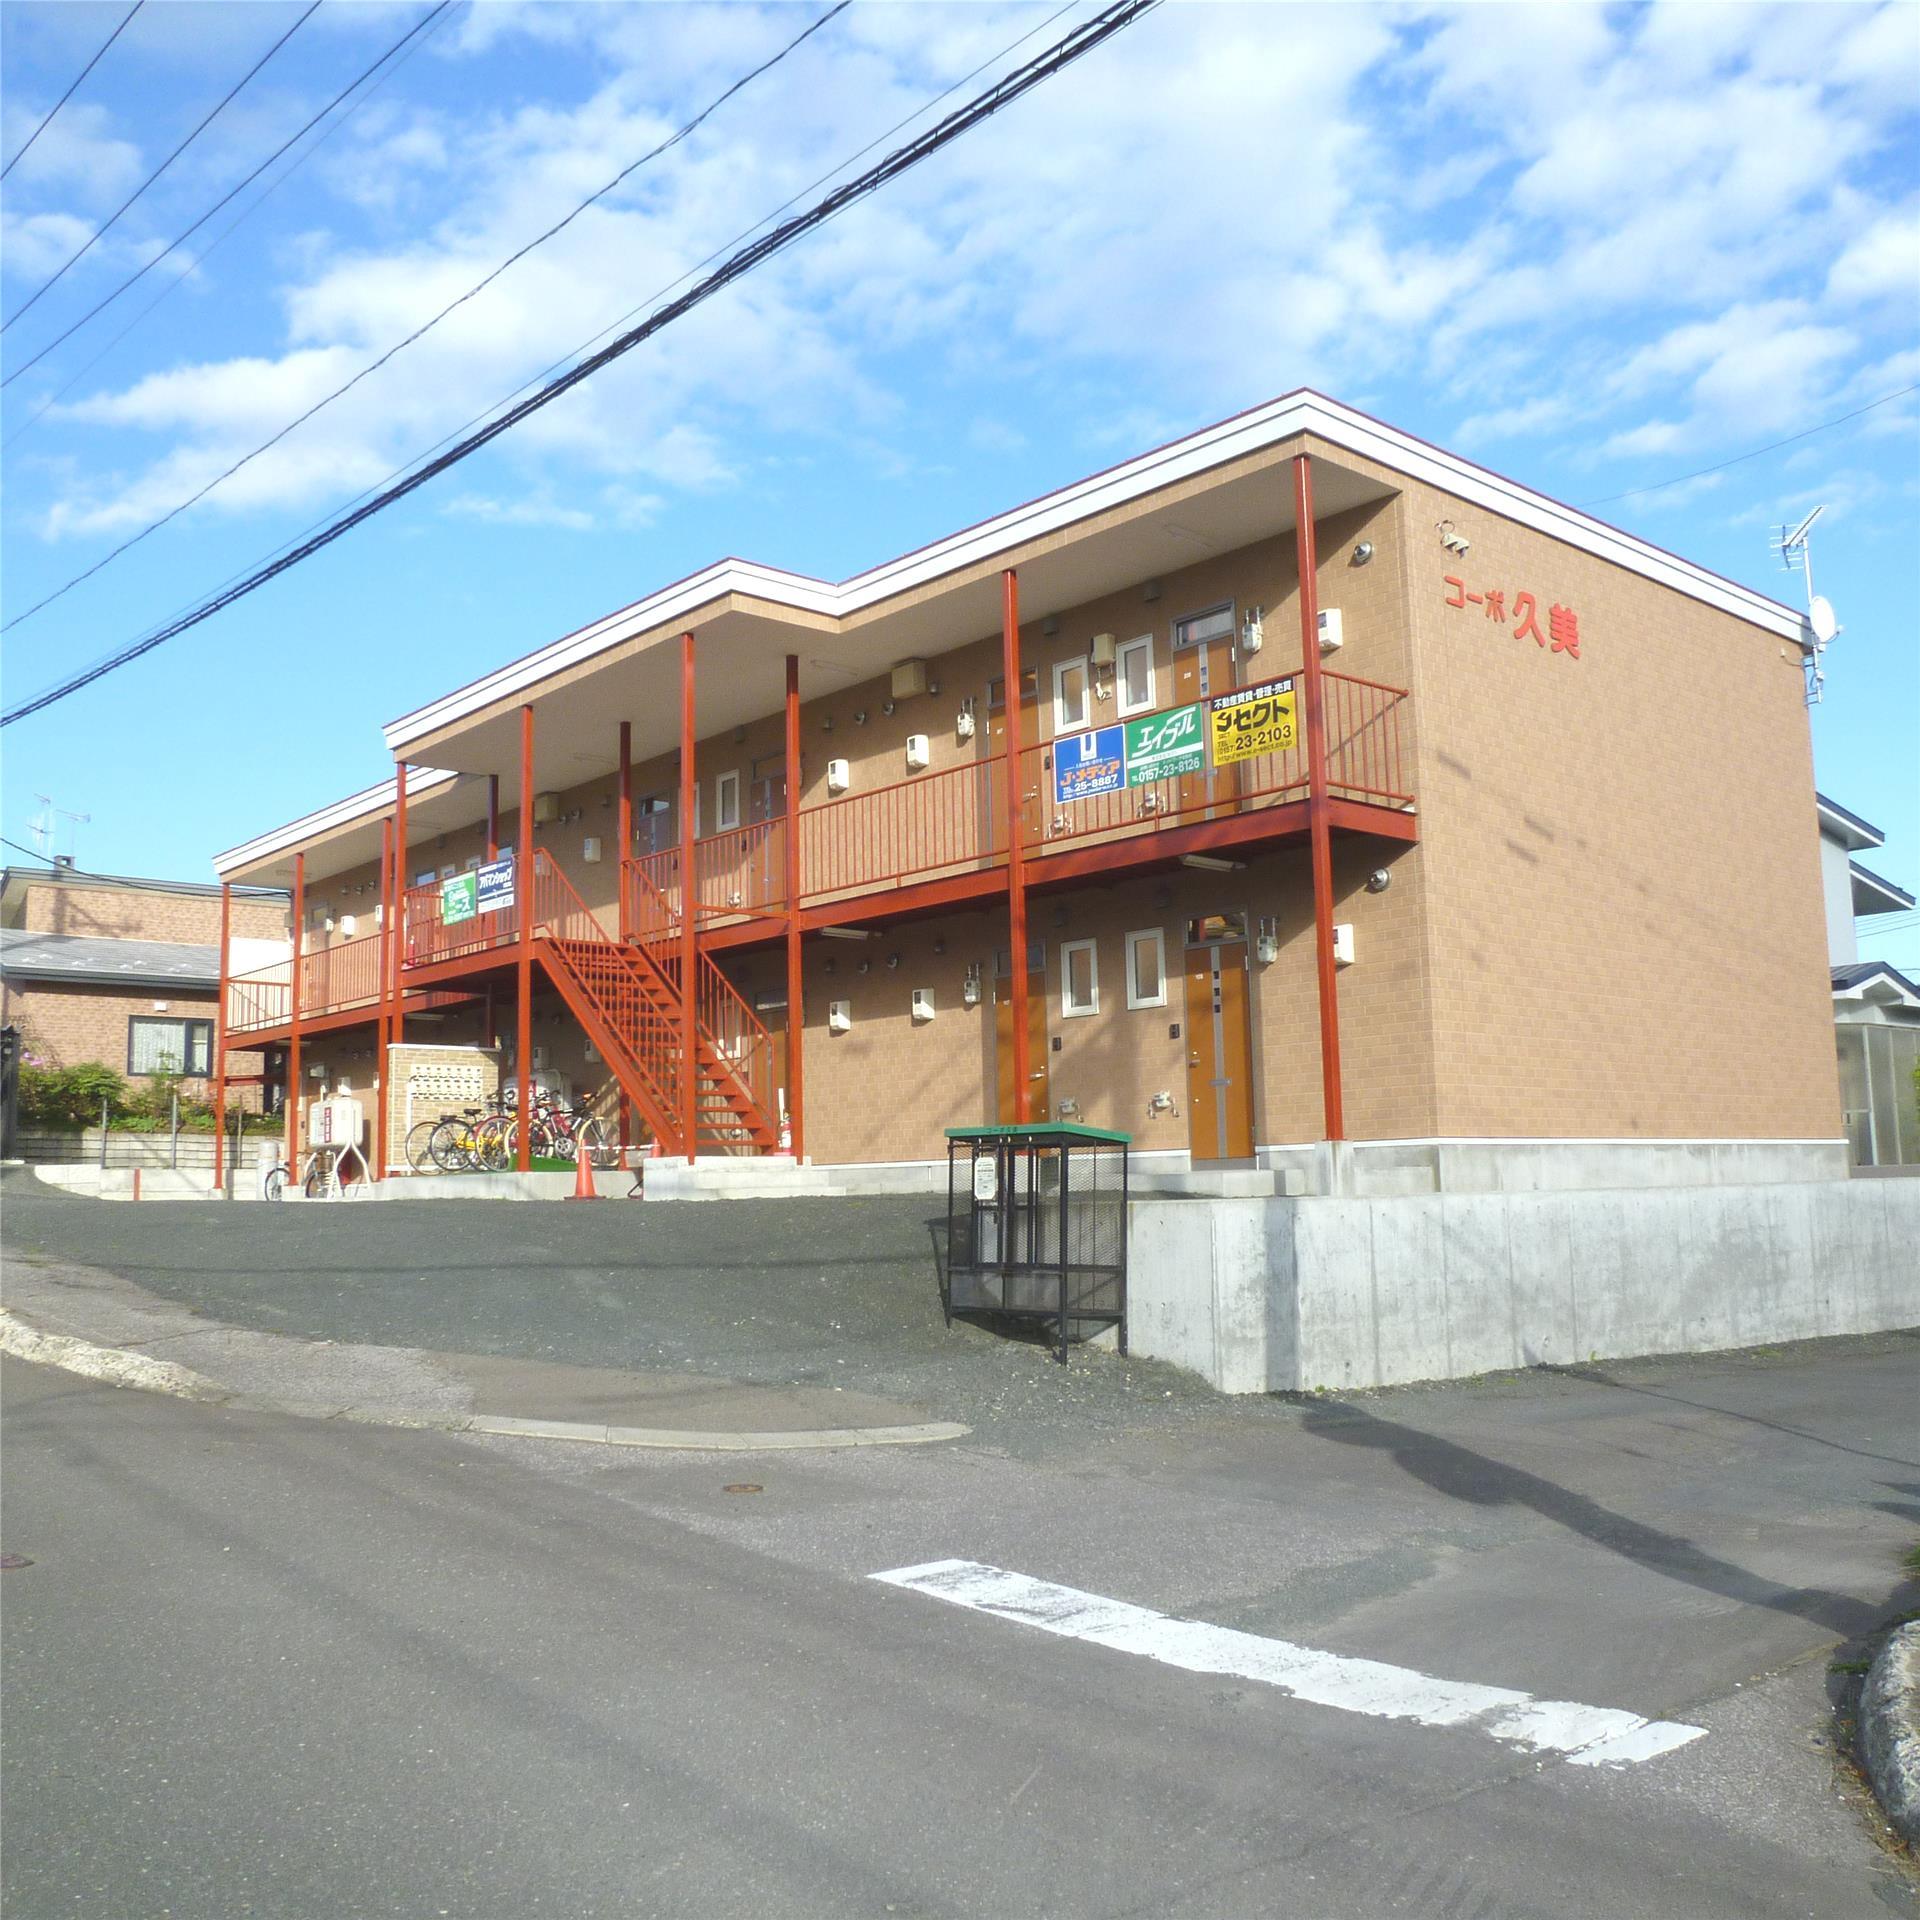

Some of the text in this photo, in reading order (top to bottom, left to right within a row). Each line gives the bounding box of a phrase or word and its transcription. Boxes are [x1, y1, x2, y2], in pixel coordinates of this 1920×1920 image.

[1443, 575, 1581, 661] コーポ久美
[1131, 706, 1196, 758] エイブル
[1236, 725, 1291, 751] 23-2103
[1074, 773, 1118, 792] 25-8887
